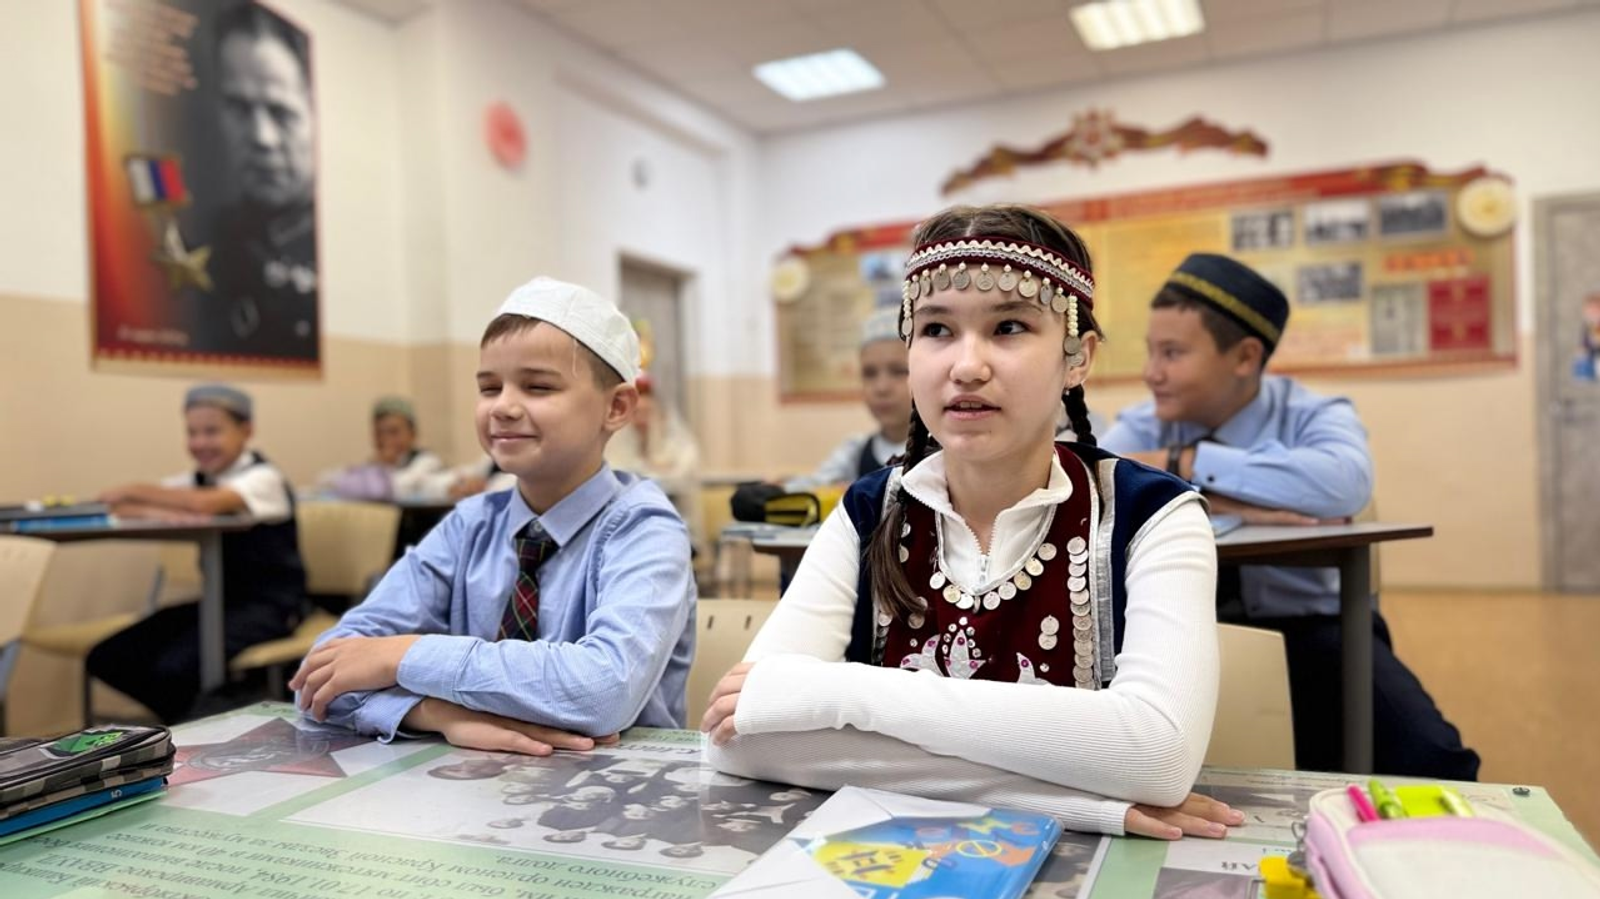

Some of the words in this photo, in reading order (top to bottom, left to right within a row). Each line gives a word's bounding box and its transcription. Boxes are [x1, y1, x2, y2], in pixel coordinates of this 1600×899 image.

[106, 833, 174, 848] южнее
[155, 826, 251, 844] мужество
[68, 842, 188, 865] выполнения
[170, 843, 202, 852] км
[196, 847, 228, 857] 40
[272, 842, 349, 860] Звезды
[185, 861, 250, 875] после
[244, 853, 394, 880] мятежниками
[344, 851, 446, 873] Красной
[496, 855, 568, 871] долга.
[117, 867, 260, 895] Армавирское
[393, 874, 452, 890] сбит
[446, 865, 550, 886] орденом
[567, 865, 717, 889] служебного
[68, 877, 206, 899] ктябрьский
[455, 882, 506, 898] был
